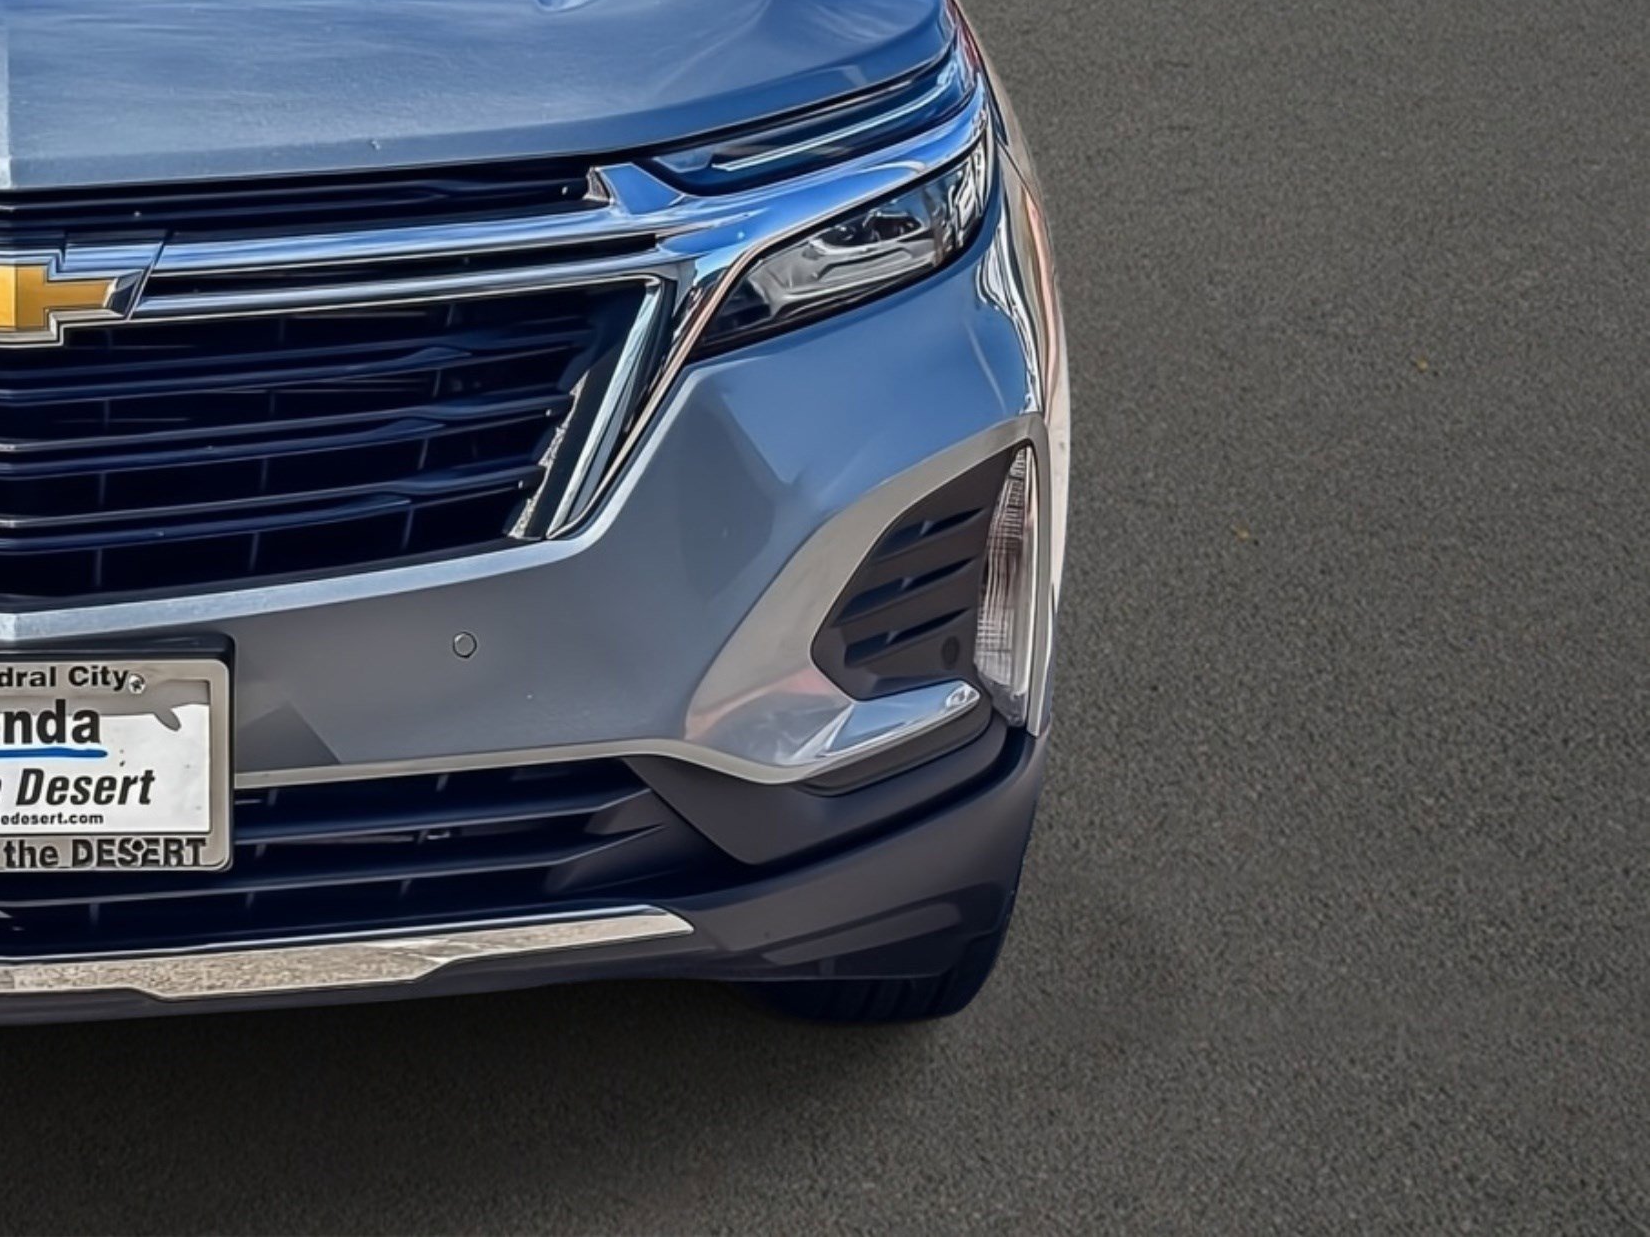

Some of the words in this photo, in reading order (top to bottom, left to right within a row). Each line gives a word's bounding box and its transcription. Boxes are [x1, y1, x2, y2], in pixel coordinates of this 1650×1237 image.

[67, 665, 130, 691] City
[16, 768, 156, 806] Desert
[3, 838, 59, 869] the
[71, 836, 207, 868] DESERT
